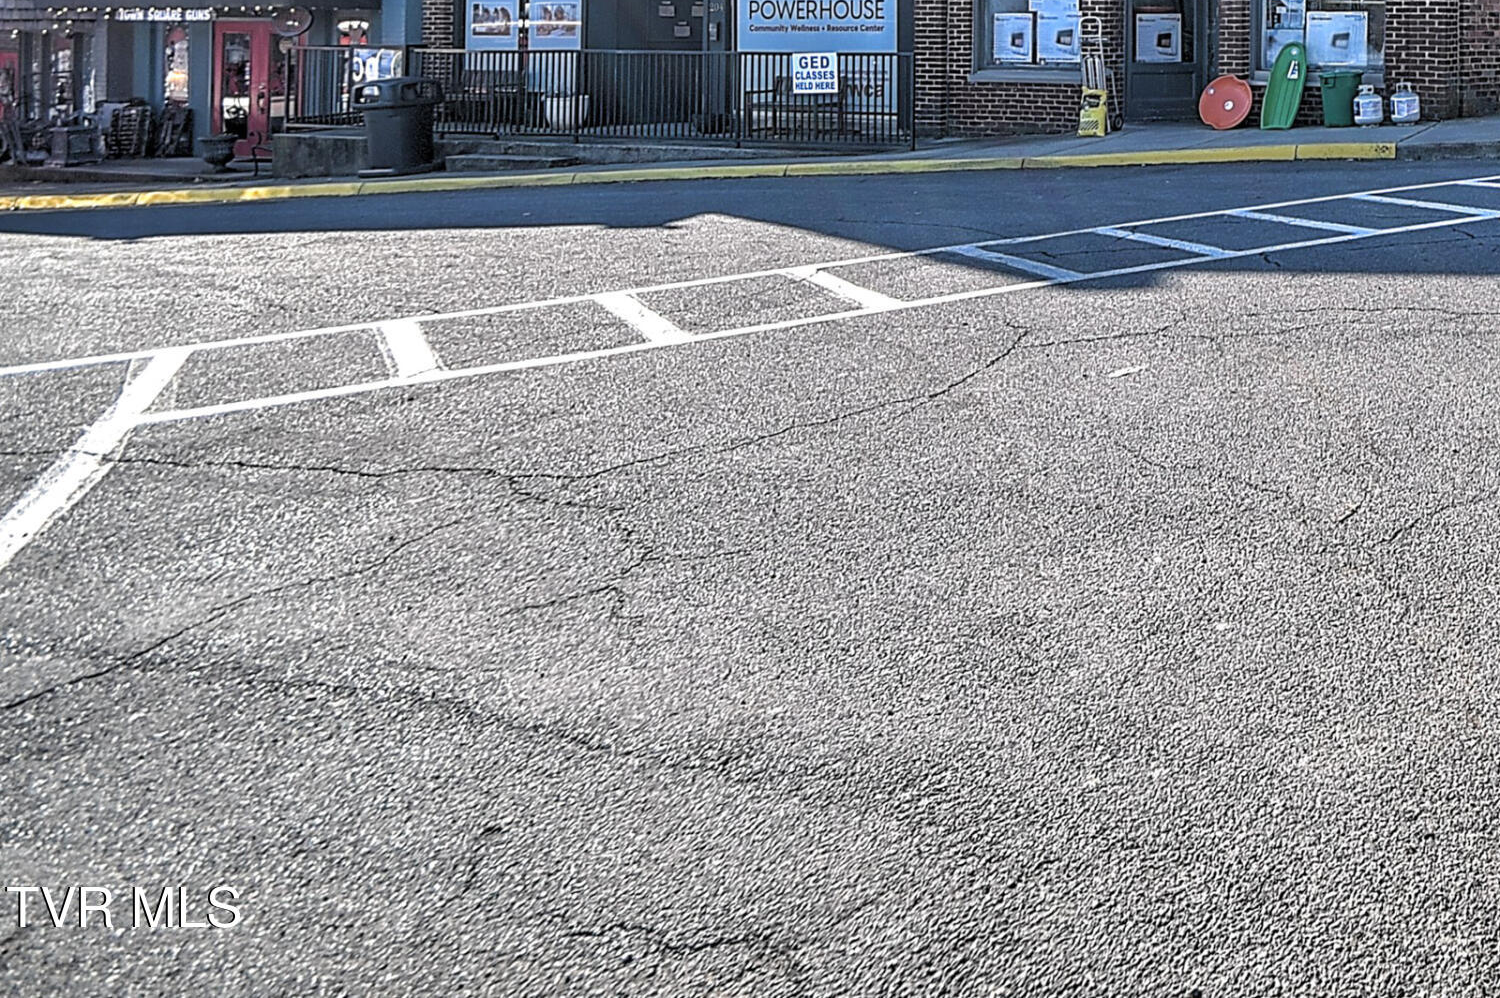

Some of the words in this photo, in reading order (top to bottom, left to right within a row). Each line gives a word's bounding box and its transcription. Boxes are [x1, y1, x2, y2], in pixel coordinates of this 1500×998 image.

[185, 8, 212, 21] GUNS
[749, 24, 788, 33] Community
[790, 24, 820, 32] Wellness
[826, 24, 858, 32] Resource
[860, 24, 885, 32] Center
[799, 56, 830, 69] GED
[795, 71, 835, 80] CLASSES
[795, 81, 813, 90] HELD
[815, 81, 835, 90] HERE
